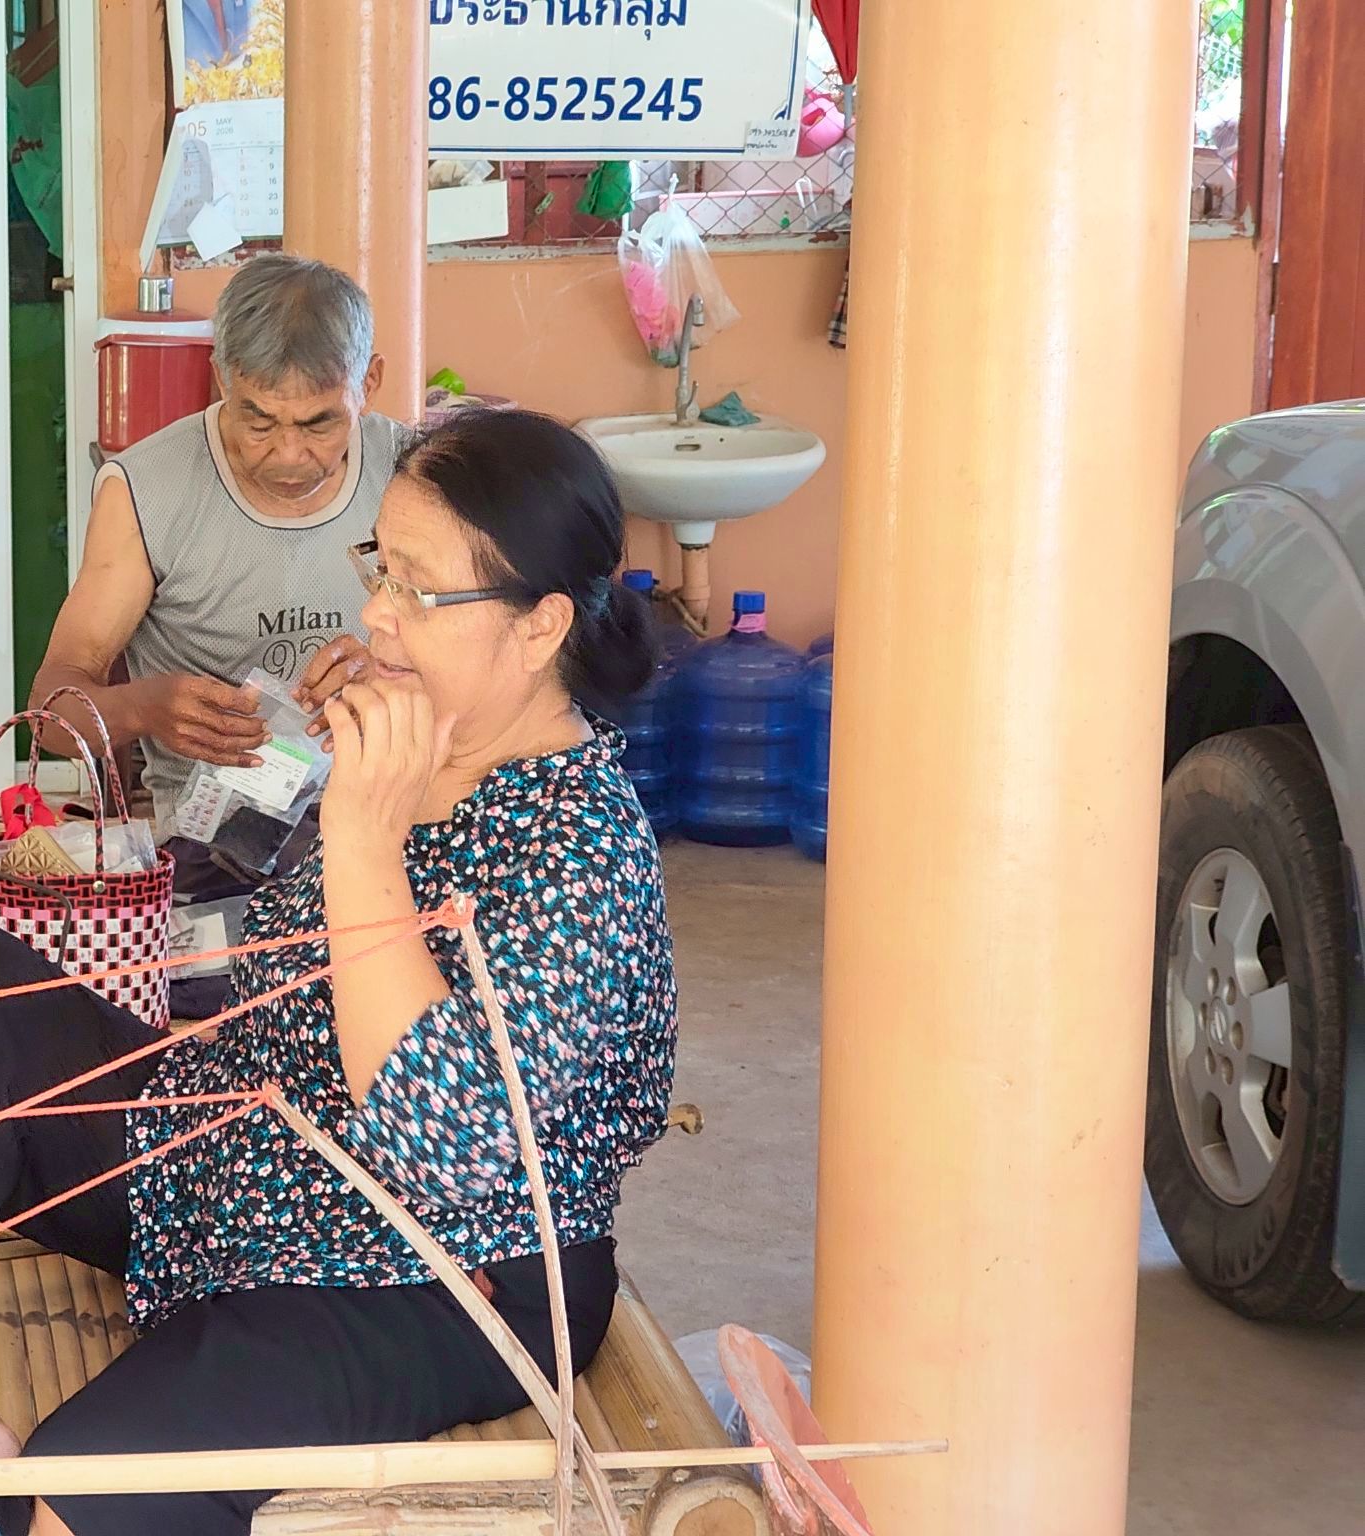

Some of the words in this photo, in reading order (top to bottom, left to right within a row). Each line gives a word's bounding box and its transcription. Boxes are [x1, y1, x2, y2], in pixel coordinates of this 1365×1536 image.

[429, 0, 686, 40] ประธานกลุม
[216, 117, 233, 125] MAY
[258, 606, 342, 637] Milan
